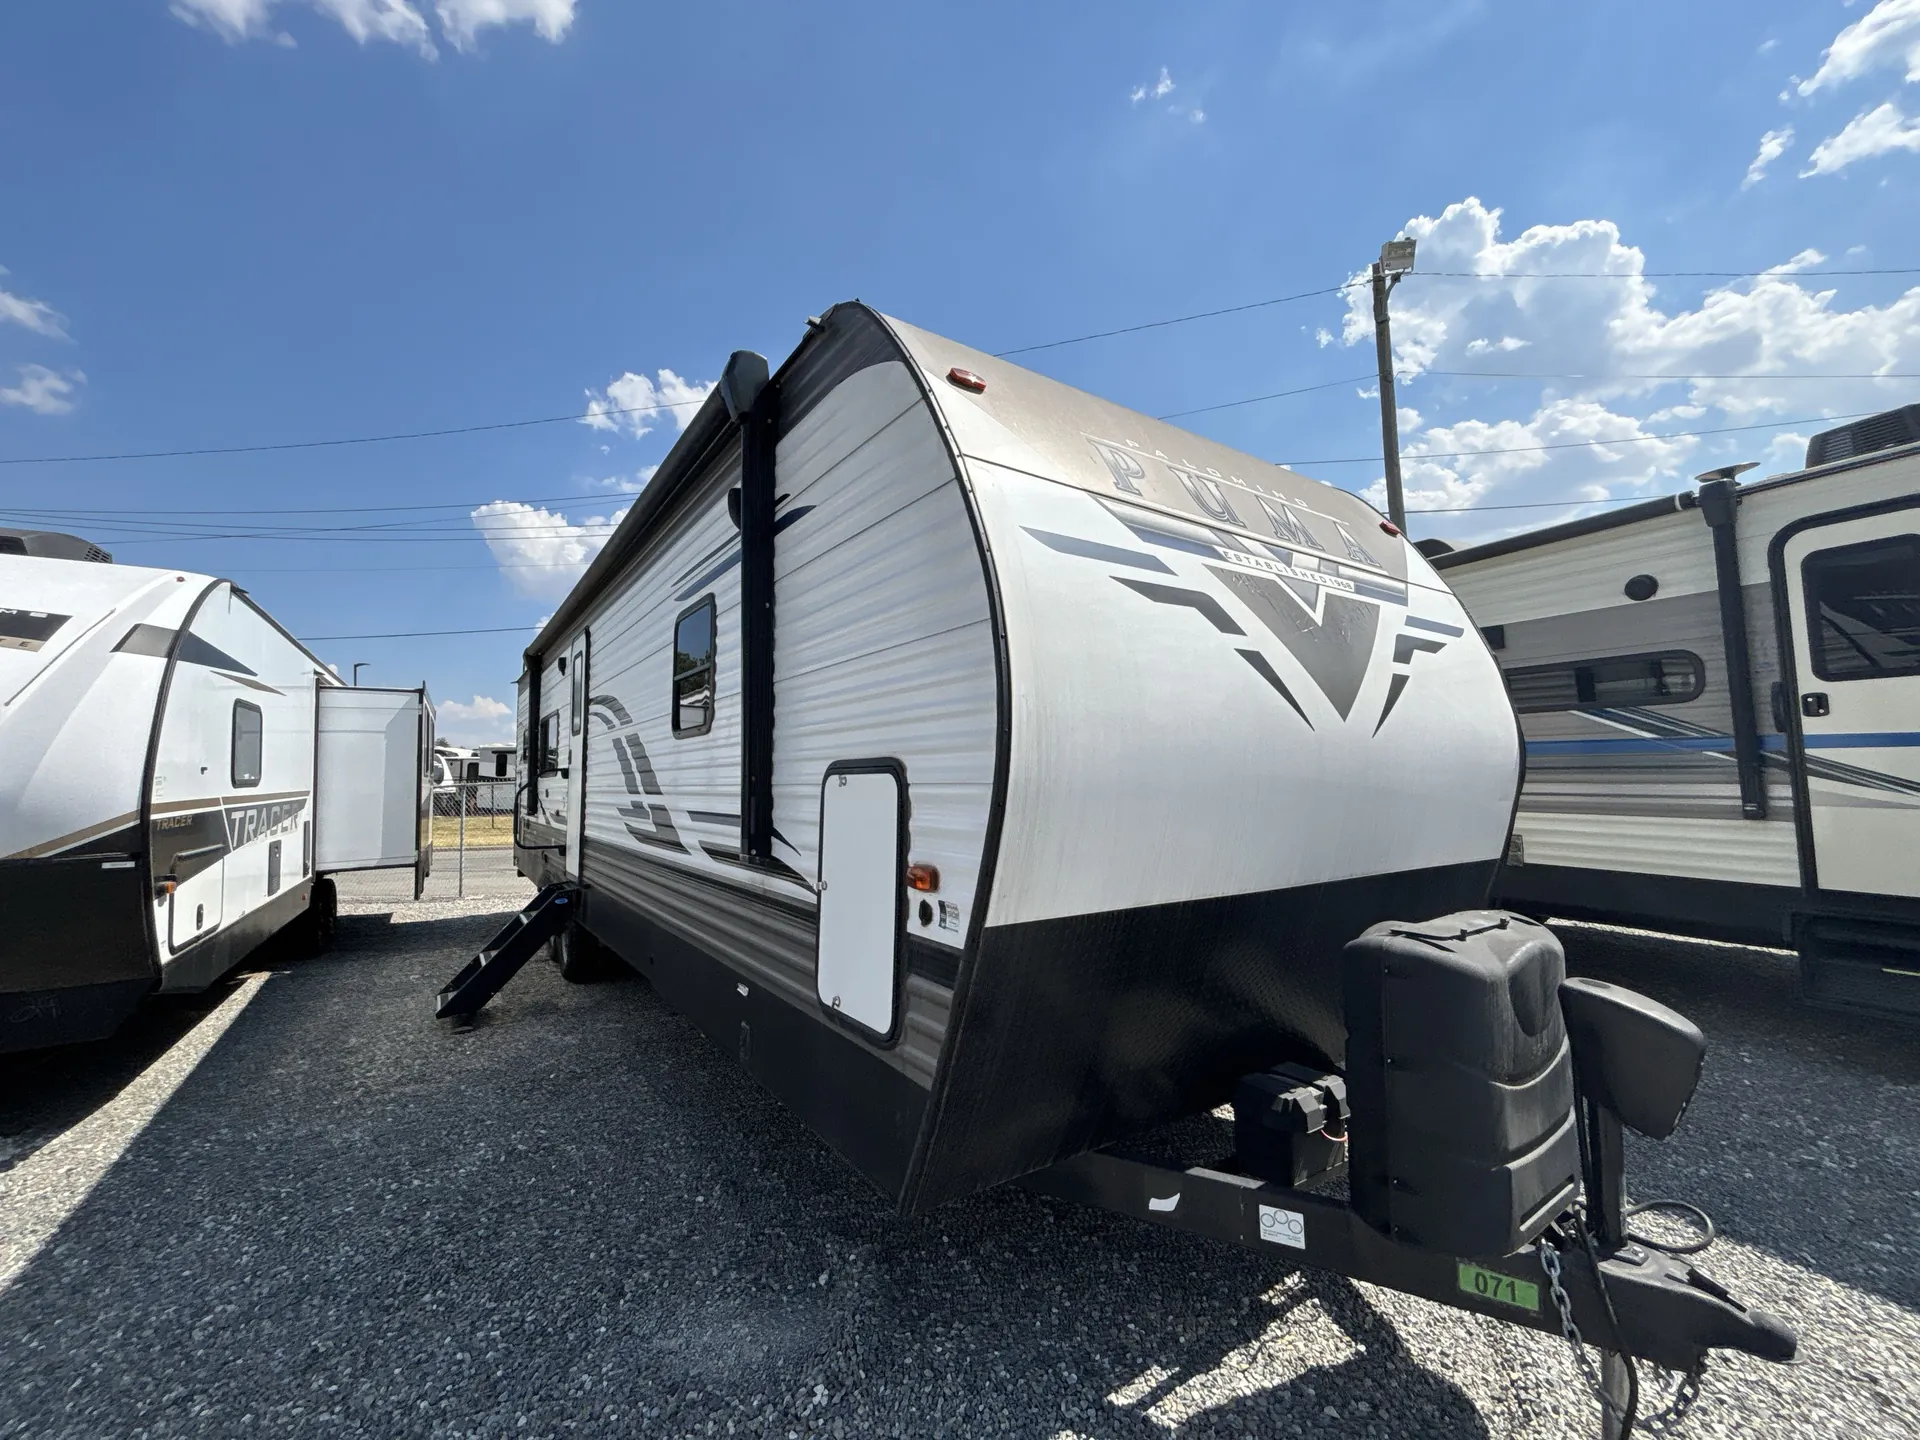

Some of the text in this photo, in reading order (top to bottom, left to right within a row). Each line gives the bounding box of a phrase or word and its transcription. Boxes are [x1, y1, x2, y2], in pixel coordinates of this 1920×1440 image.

[1126, 438, 1308, 508] PALOMINO
[1085, 437, 1383, 568] PUMA
[1222, 550, 1353, 590] ESTABLISHED 1968
[156, 815, 193, 830] TRACER
[231, 803, 301, 848] TRACER
[1475, 1272, 1516, 1302] 071
